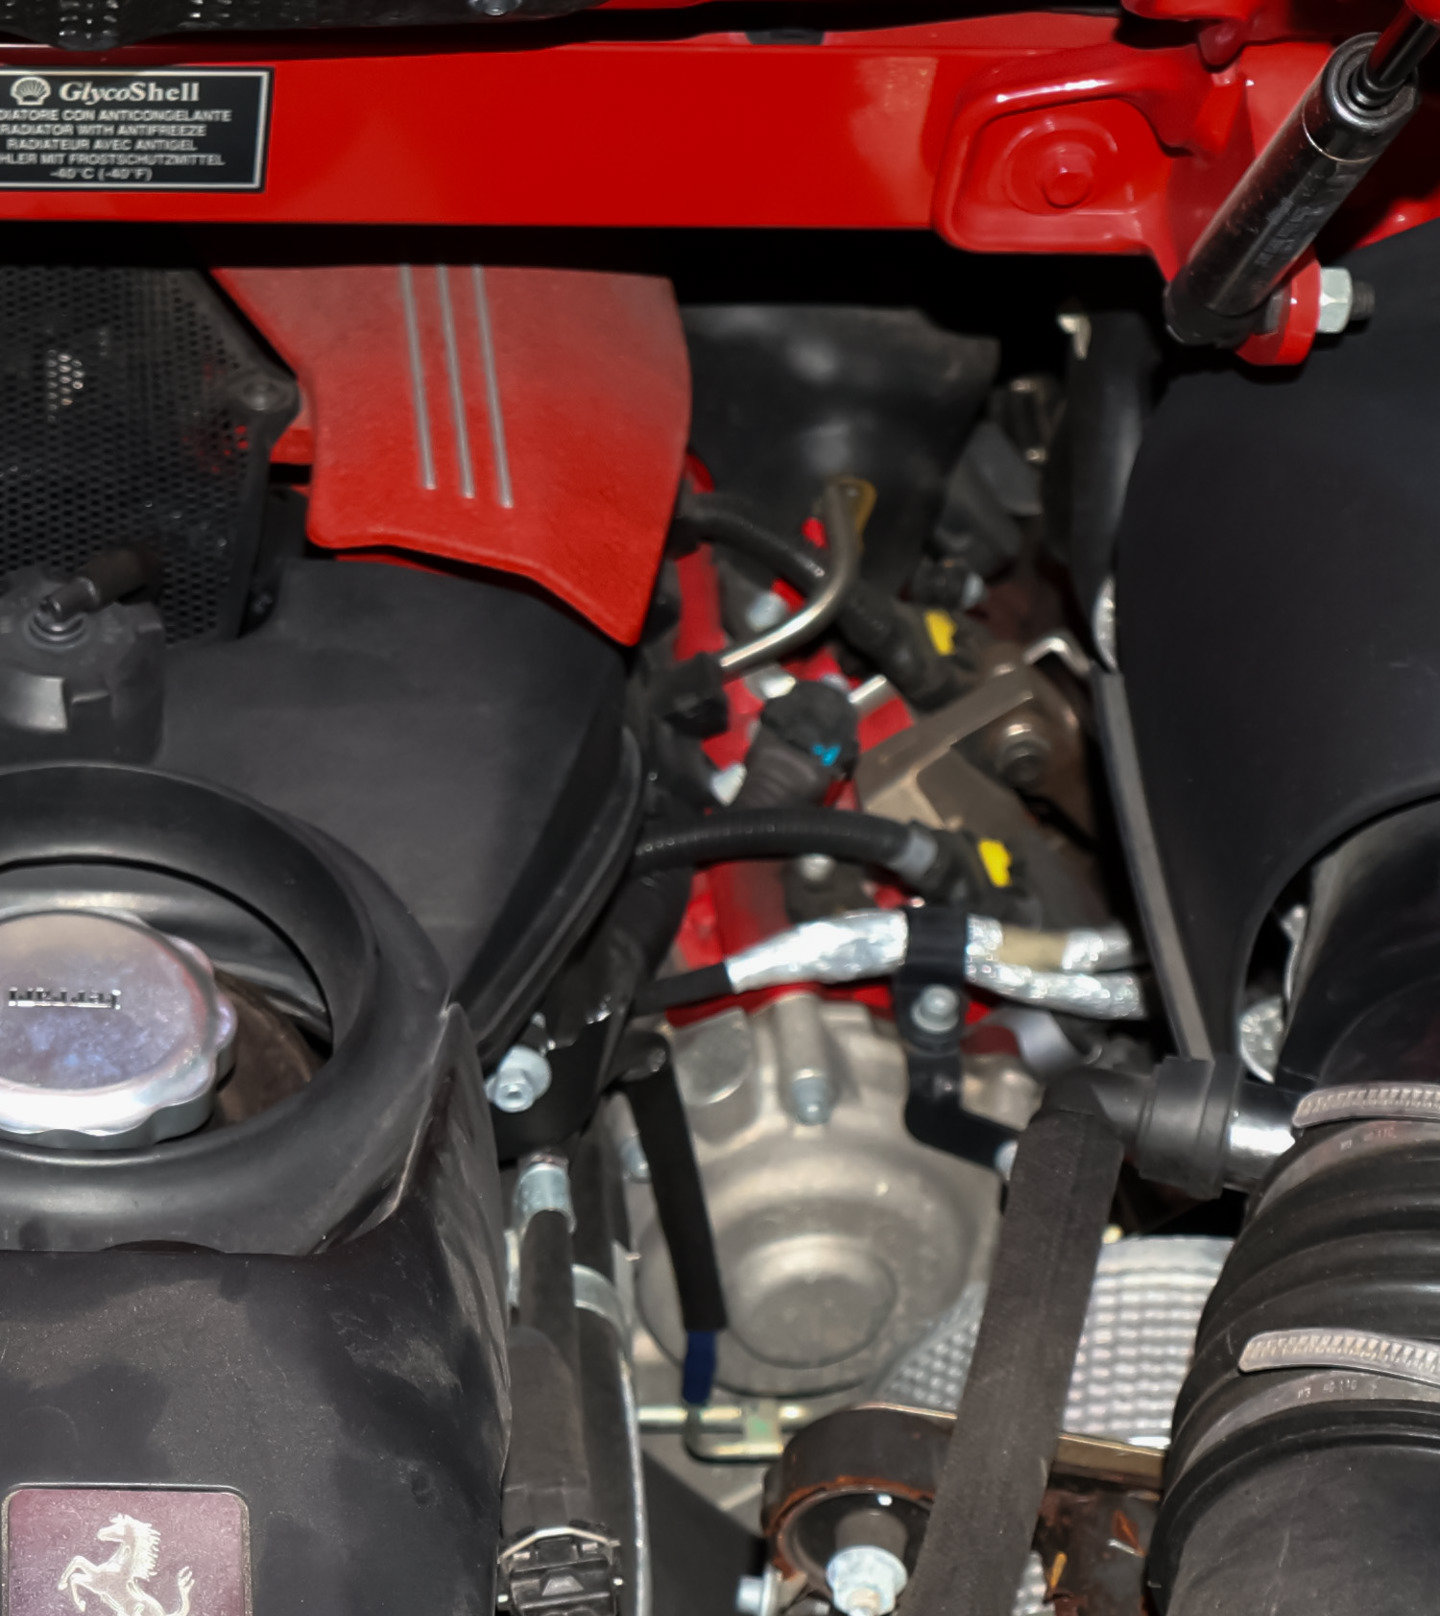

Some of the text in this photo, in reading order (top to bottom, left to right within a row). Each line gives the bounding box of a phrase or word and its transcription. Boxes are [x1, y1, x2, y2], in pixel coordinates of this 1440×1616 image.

[59, 81, 200, 105] GlycoShell
[61, 109, 95, 121] CON
[98, 109, 232, 122] ANTICONGELANTE
[76, 124, 114, 136] WITH
[117, 124, 207, 137] ANTIFREEZE
[6, 138, 198, 151] RADIATEUR AVEC ANTIGEL
[40, 153, 66, 165] MIT
[68, 153, 226, 166] FROSTSCHUTZMITTEL
